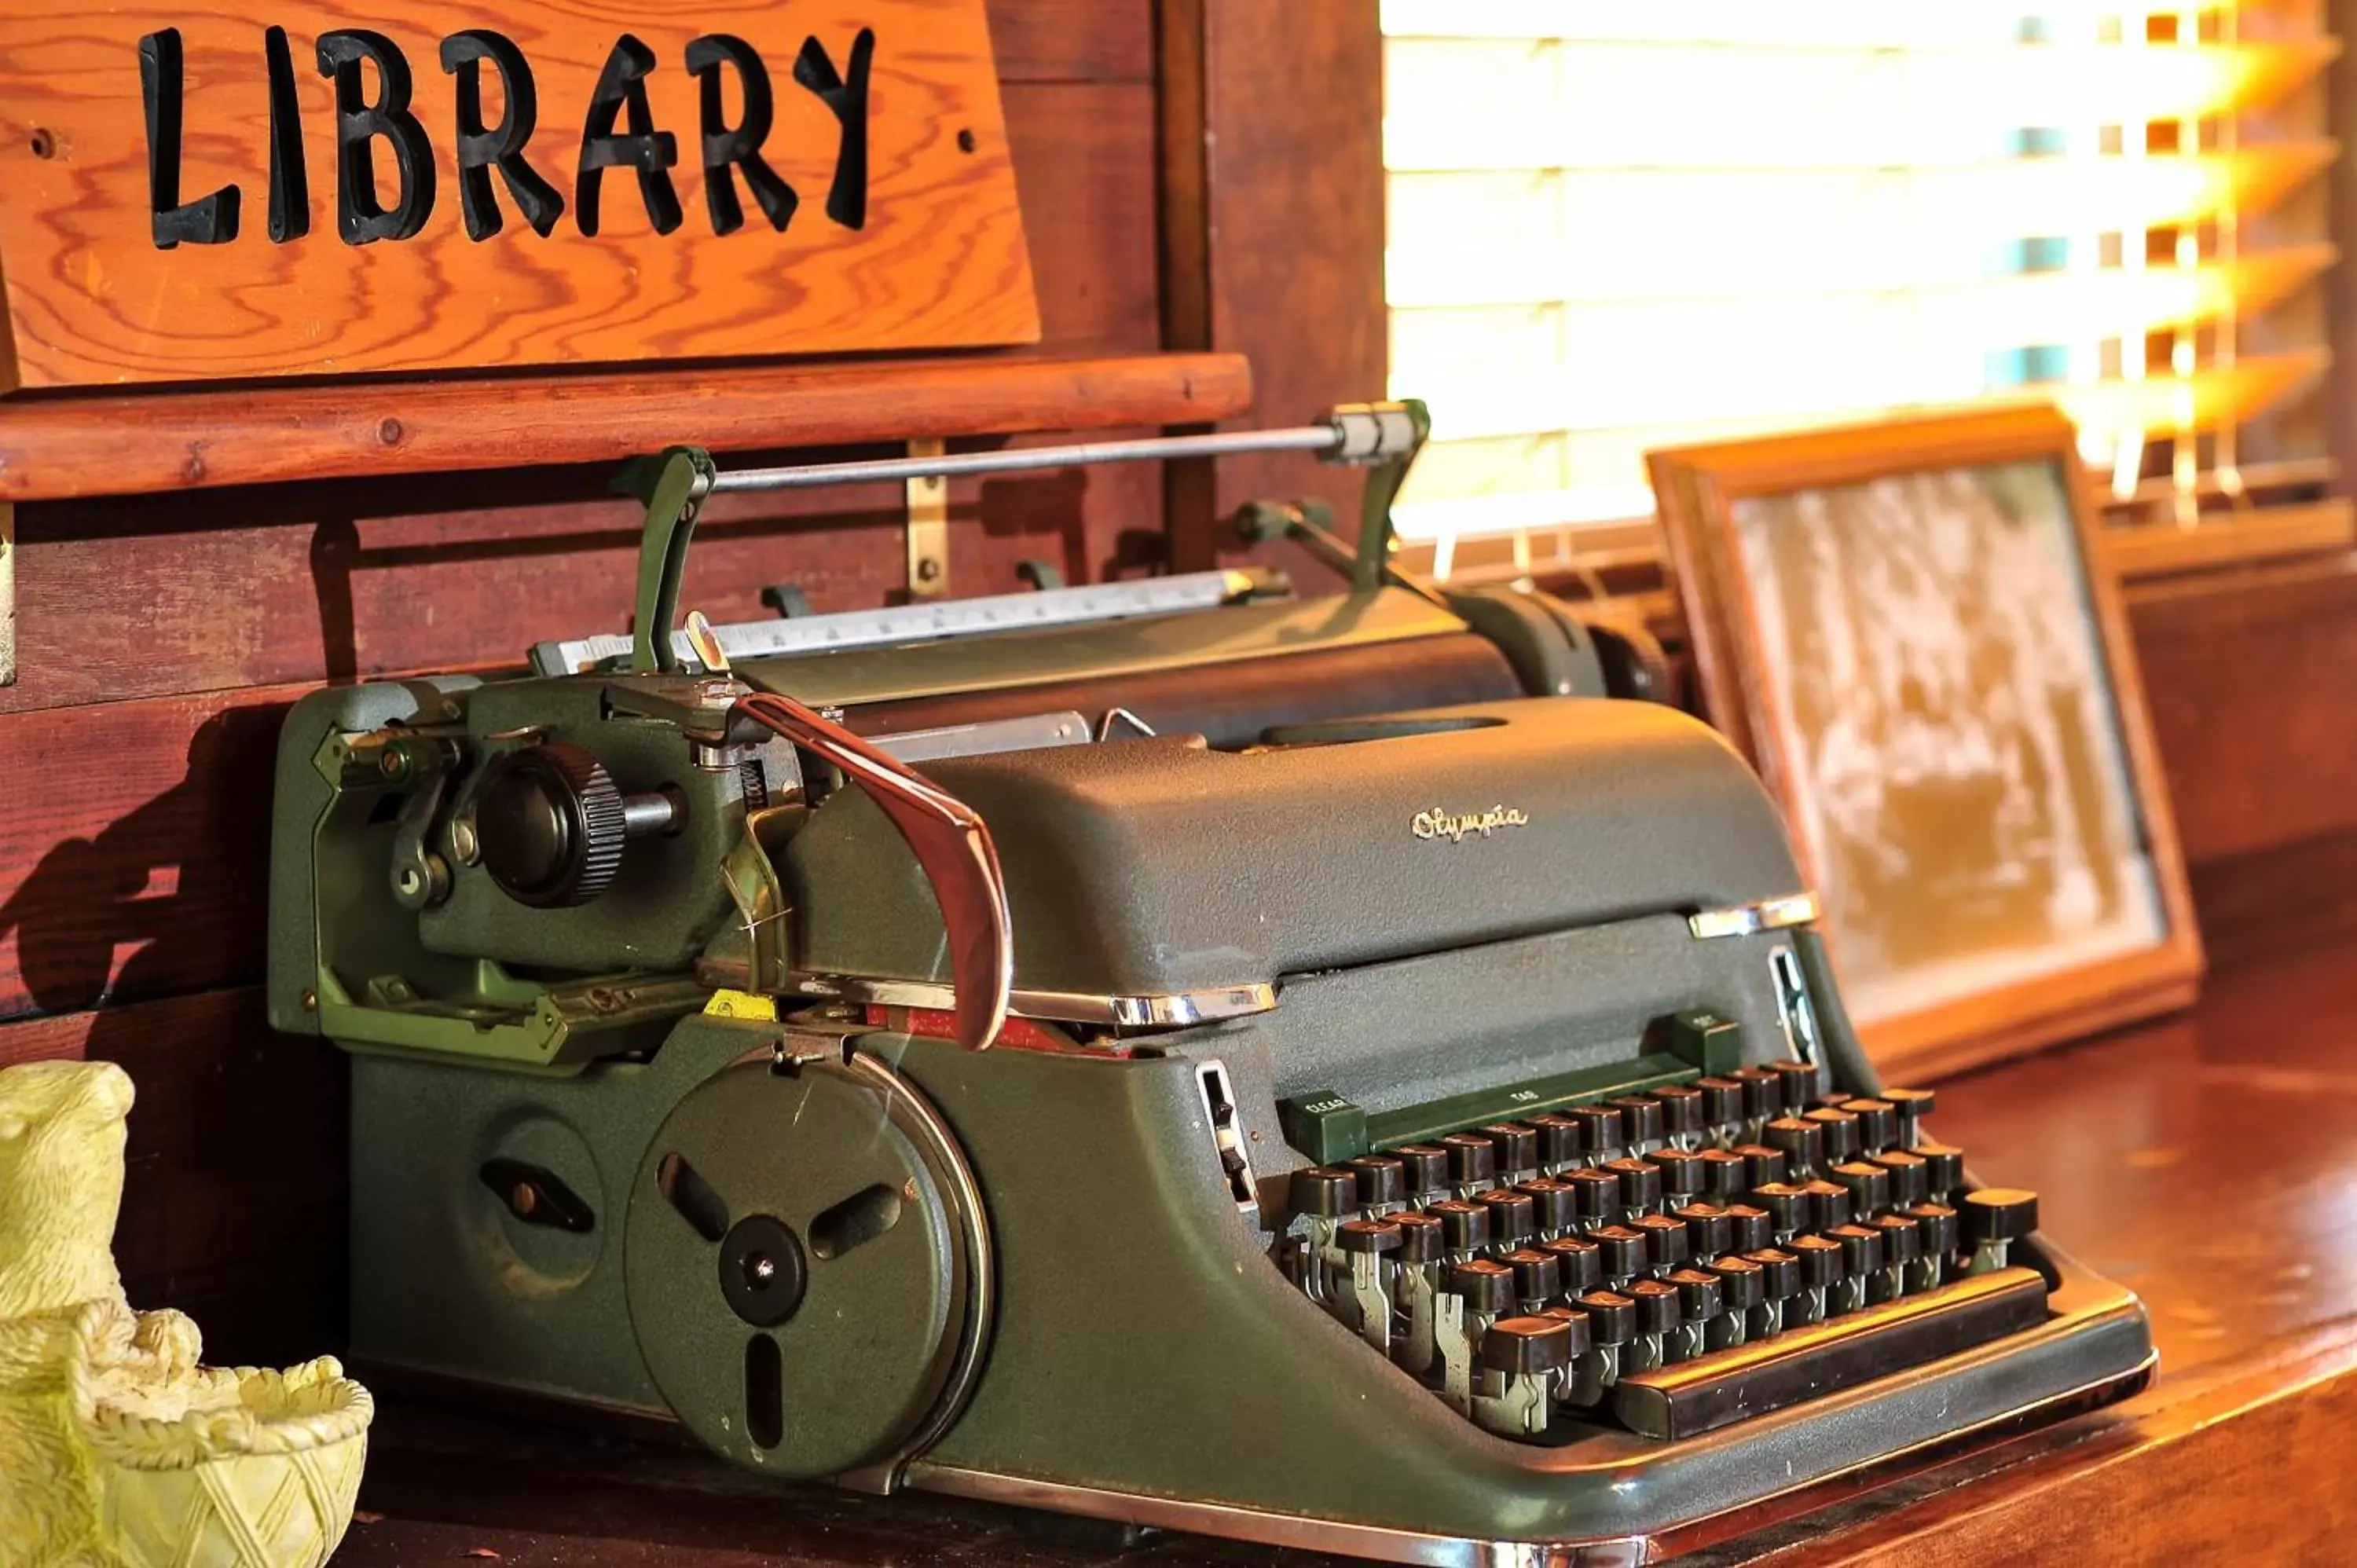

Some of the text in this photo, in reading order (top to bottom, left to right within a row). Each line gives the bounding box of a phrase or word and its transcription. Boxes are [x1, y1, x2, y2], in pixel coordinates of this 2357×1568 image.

[139, 26, 875, 249] LIBRARY
[1411, 802, 1528, 843] Olympia
[1305, 1099, 1346, 1113] CLEAR
